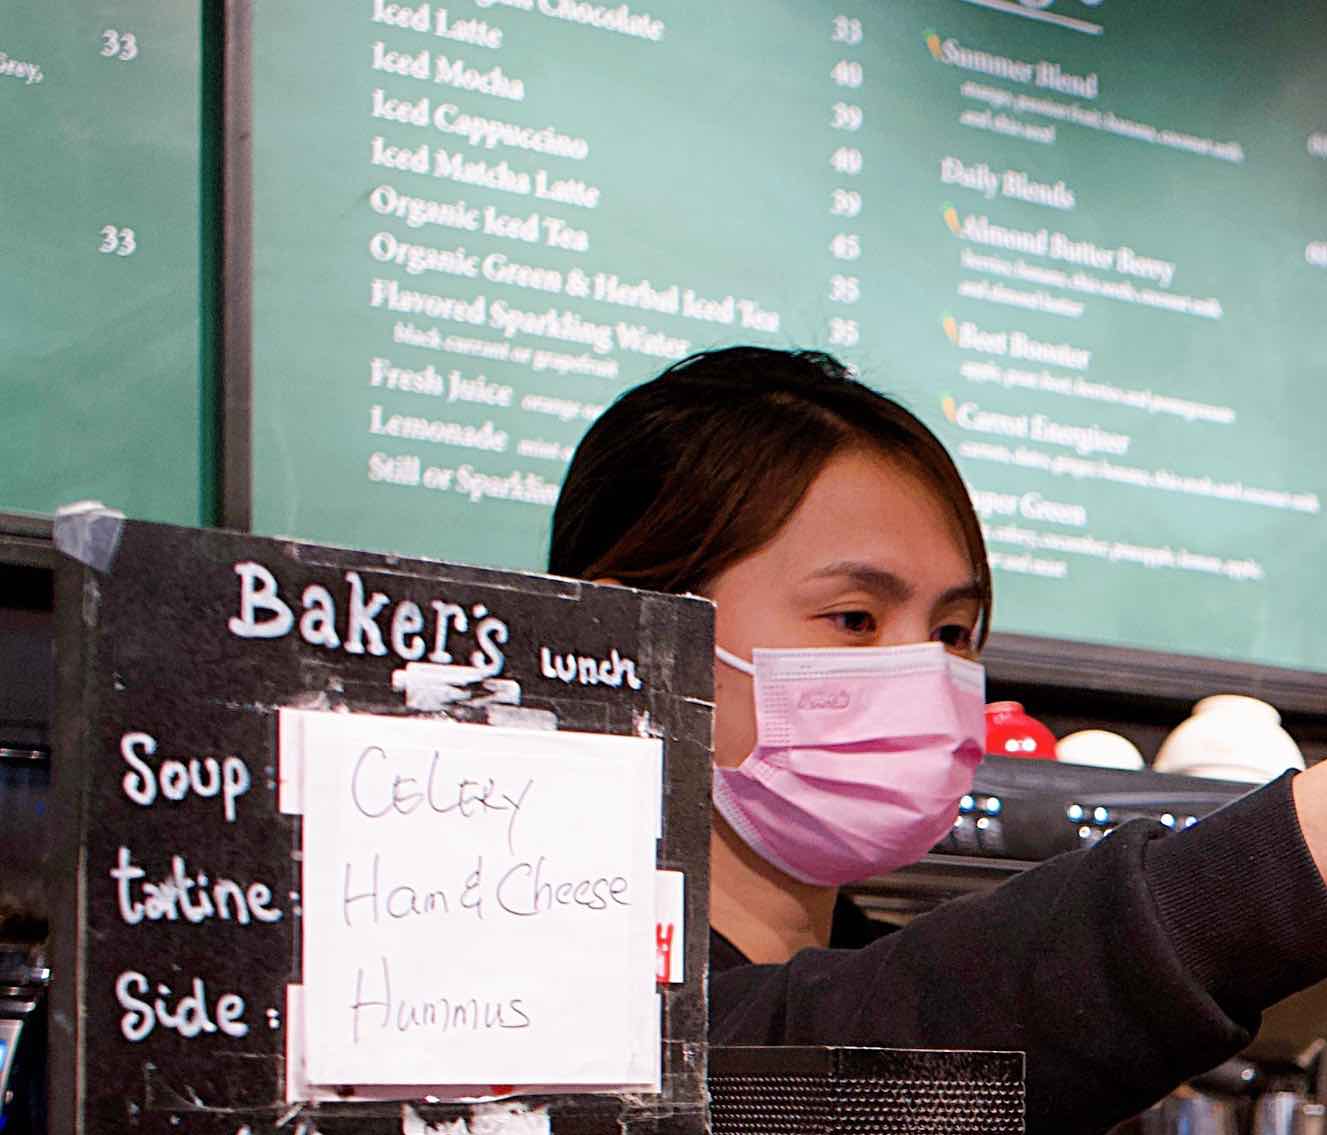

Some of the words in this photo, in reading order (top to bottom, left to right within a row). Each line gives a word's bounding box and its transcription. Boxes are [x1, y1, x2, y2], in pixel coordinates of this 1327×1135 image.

[100, 29, 138, 60] 33
[371, 0, 431, 32] Iced
[433, 7, 503, 49] Latte
[371, 41, 431, 80] Iced
[433, 55, 525, 101] Mocha
[942, 38, 1032, 83] Summer
[1035, 60, 1098, 99] Blend
[371, 88, 431, 127] Iced
[432, 103, 589, 160] Cappuccino
[371, 135, 431, 174] Iced
[433, 148, 531, 195] Matcha
[535, 169, 600, 208] Latte
[941, 156, 997, 200] Daily
[1002, 169, 1075, 209] Blends
[99, 224, 137, 256] 33
[369, 184, 481, 229] Organic
[483, 205, 540, 243] Iced
[543, 216, 589, 250] Tea
[960, 214, 1048, 256] Almond
[1049, 232, 1114, 269] Butter
[1116, 247, 1176, 288] Berry
[368, 232, 479, 278] Organic
[482, 254, 563, 294] Green
[565, 269, 590, 298] &
[594, 272, 680, 315] Herbal
[682, 289, 735, 325] Iced
[737, 298, 781, 333] Tea
[370, 278, 487, 326] Flavored
[489, 298, 614, 354] Sparkling
[615, 321, 690, 359] Water
[370, 358, 443, 397] Fresh
[447, 370, 514, 407] Juice
[370, 406, 509, 452] Lemonade
[368, 451, 420, 487] Still
[423, 467, 454, 491] or
[227, 560, 511, 678] Baker's
[496, 856, 633, 917] Cheese
